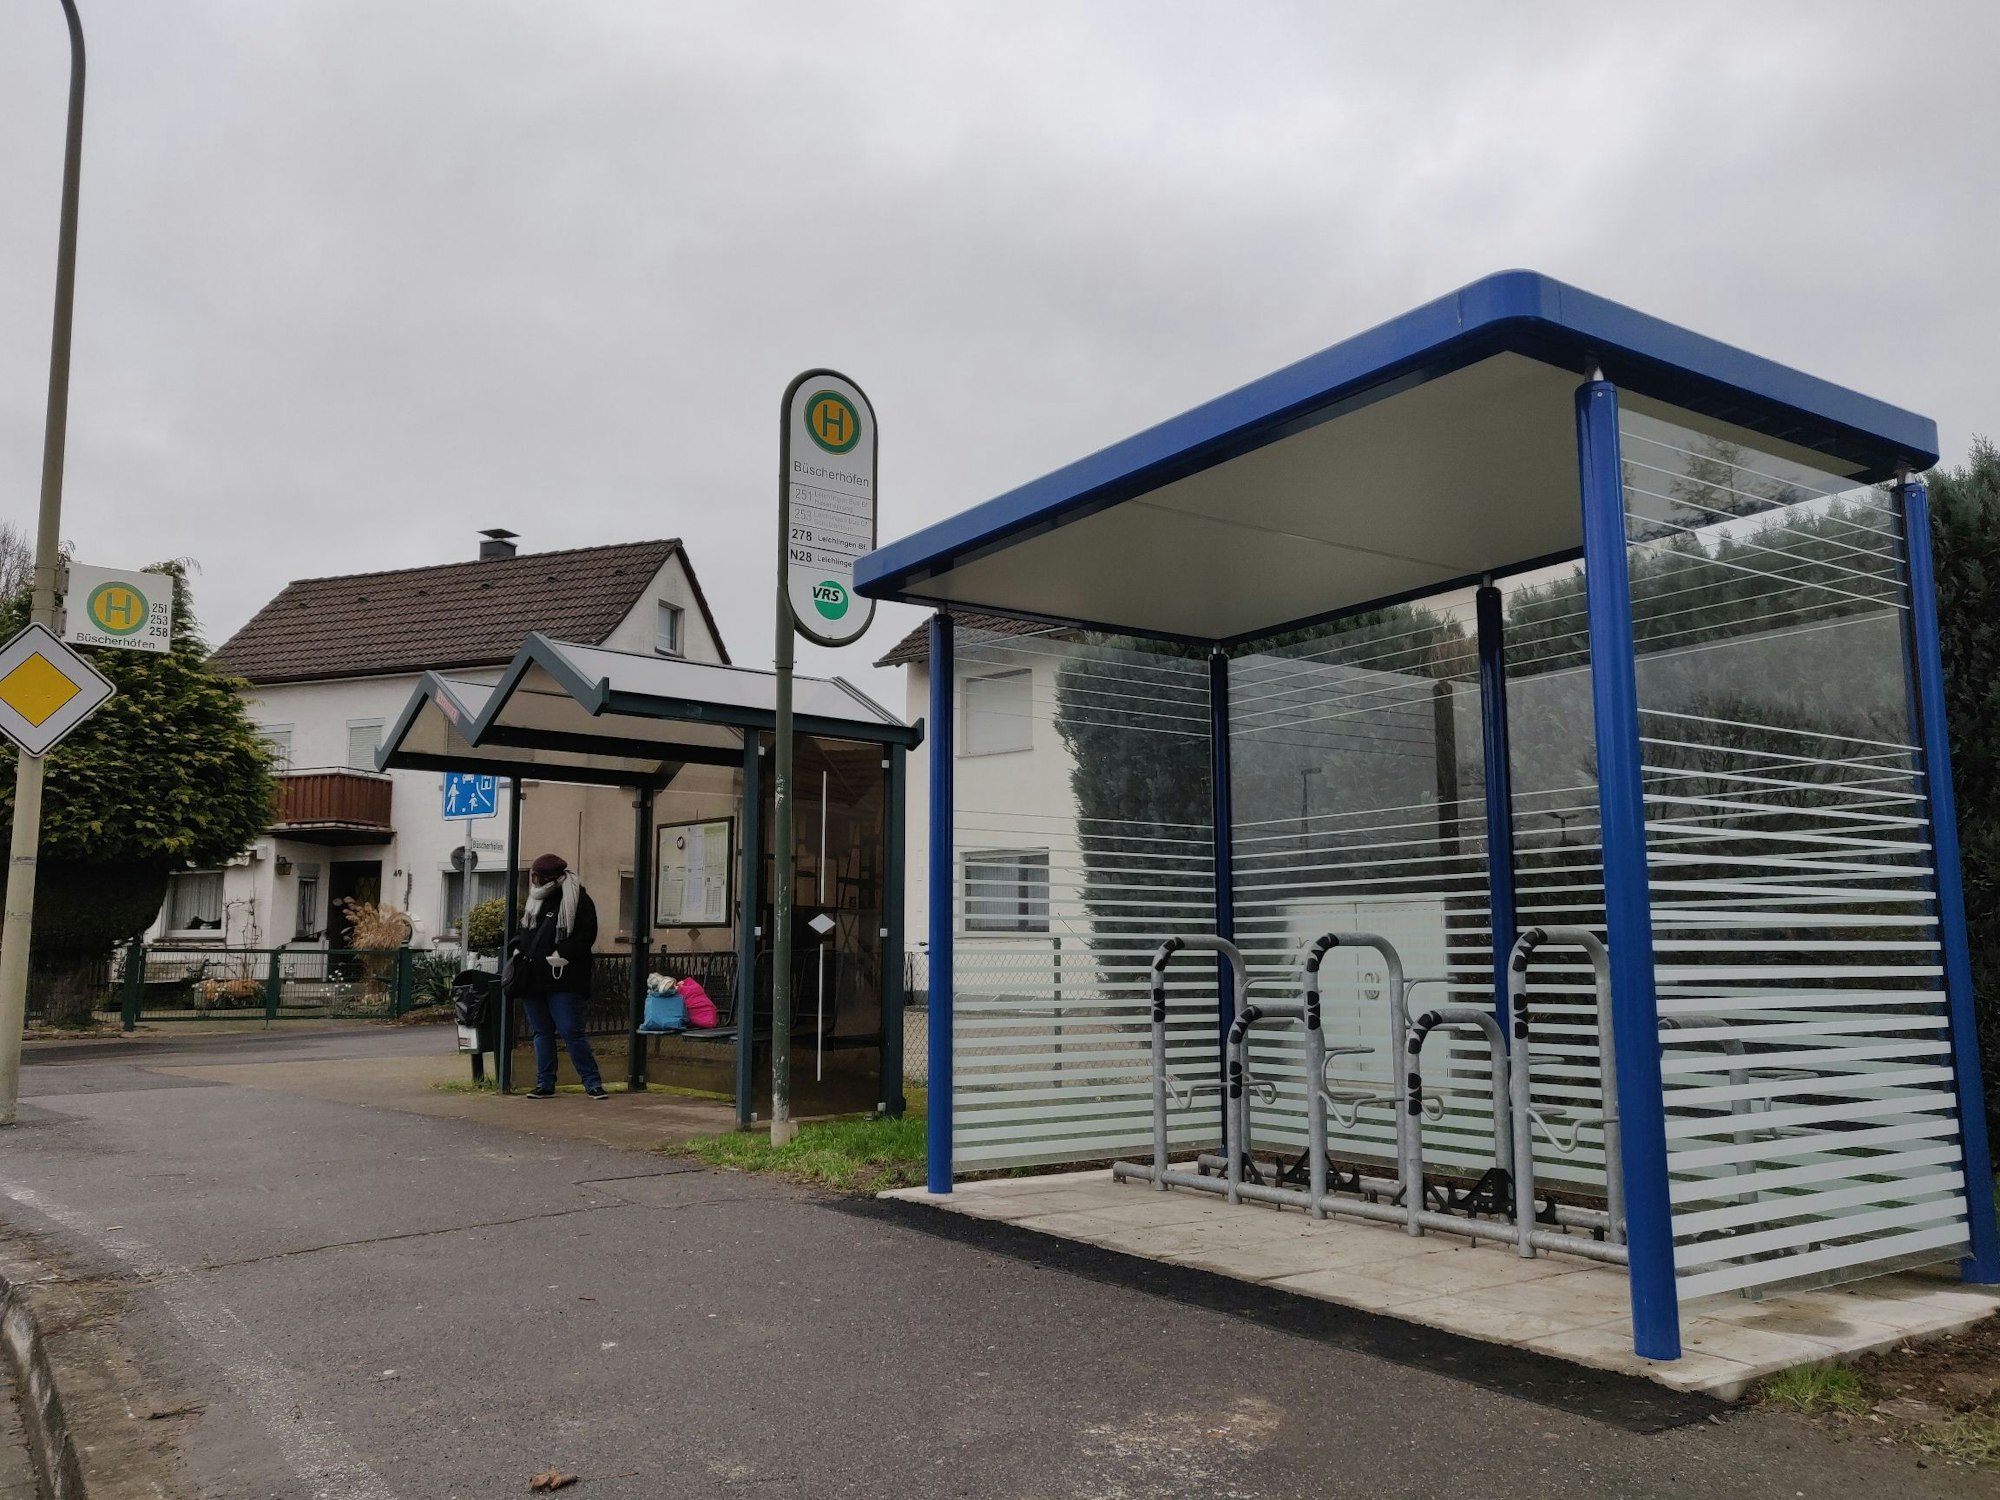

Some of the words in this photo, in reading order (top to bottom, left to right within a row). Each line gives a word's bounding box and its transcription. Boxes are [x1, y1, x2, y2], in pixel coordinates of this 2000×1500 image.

[822, 404, 843, 441] H
[794, 461, 869, 487] Büscherhöfen
[795, 488, 812, 502] 251
[794, 508, 812, 521] 253
[792, 529, 812, 541] 278
[817, 534, 857, 548] Leichlingen
[790, 549, 812, 562] N28
[817, 554, 852, 567] Leichlinge
[812, 586, 840, 602] VRS
[105, 592, 131, 624] H
[152, 603, 168, 613] 251
[150, 614, 168, 626] 253
[149, 626, 168, 637] 258
[76, 632, 155, 649] Büscherhöfen
